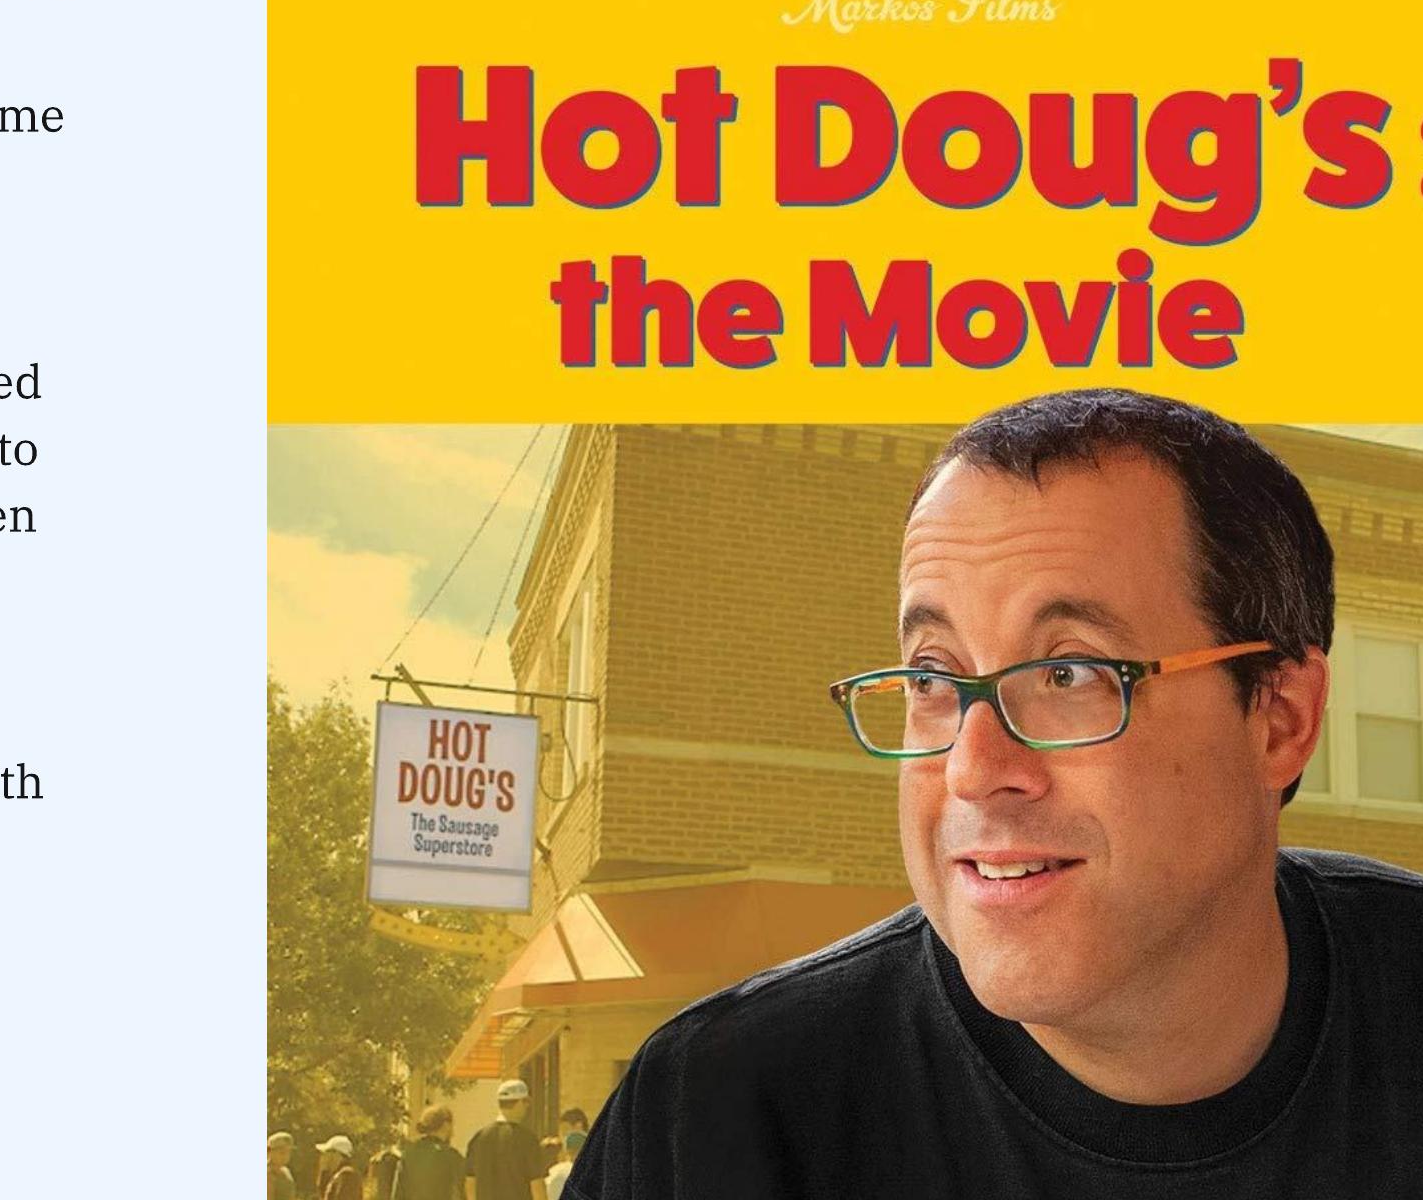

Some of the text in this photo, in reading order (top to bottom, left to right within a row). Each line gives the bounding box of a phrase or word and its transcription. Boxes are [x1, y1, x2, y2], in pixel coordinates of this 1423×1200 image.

[415, 65, 739, 210] Hot
[549, 239, 1245, 370] the Movie
[428, 719, 492, 763] HOT
[398, 761, 515, 813] DOUG'S
[410, 812, 499, 840] The Sausage
[413, 833, 494, 858] Superstore
